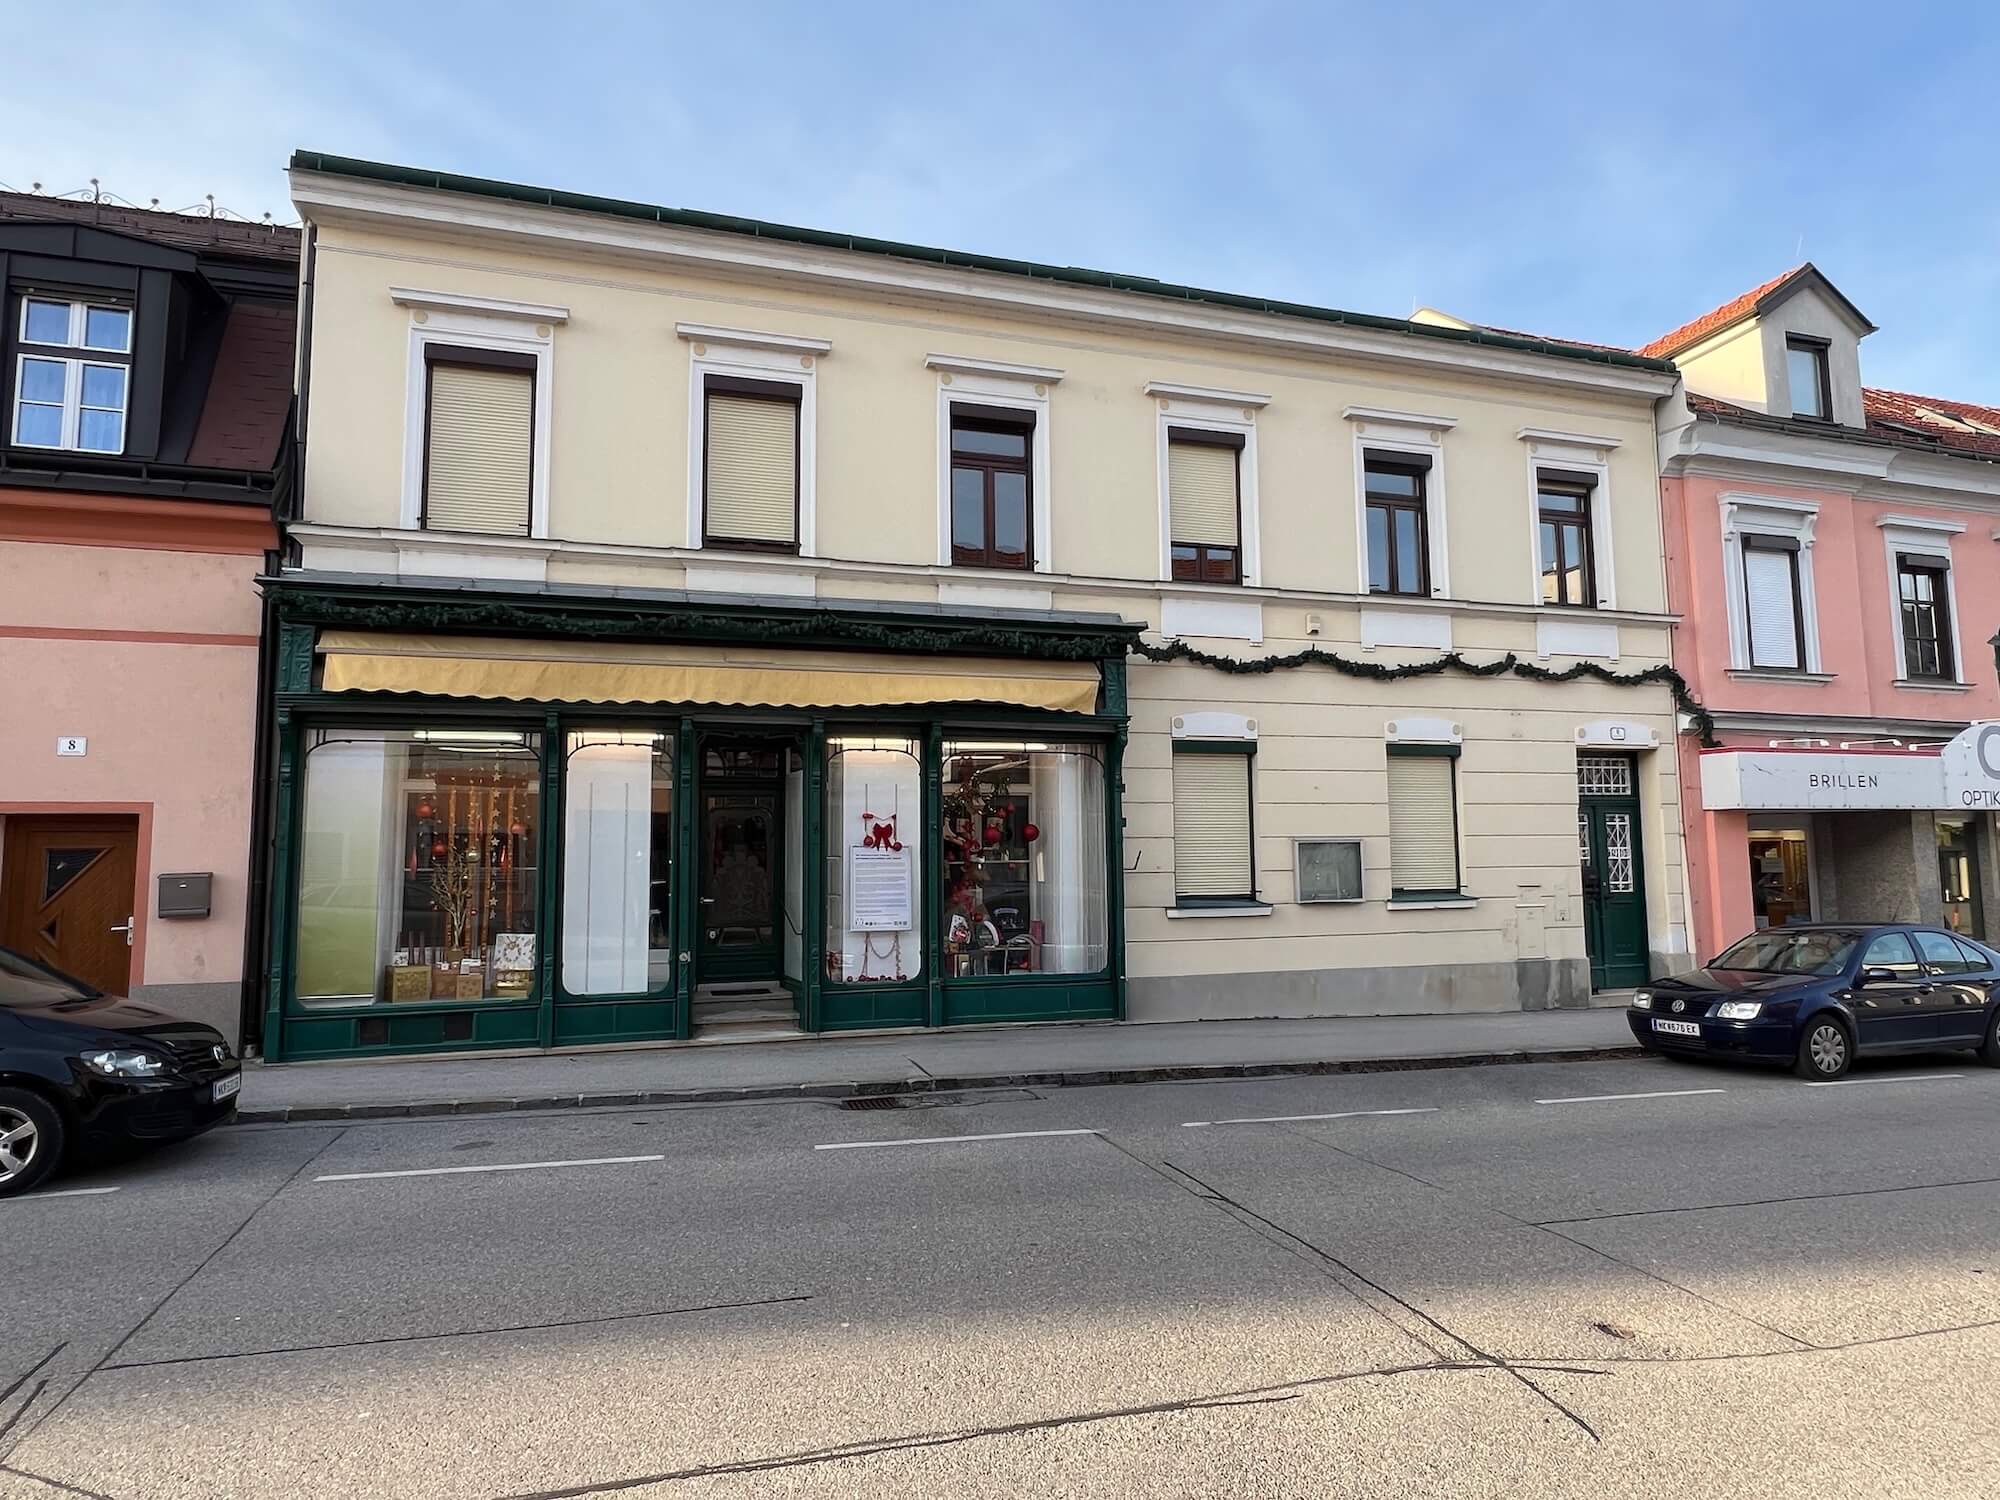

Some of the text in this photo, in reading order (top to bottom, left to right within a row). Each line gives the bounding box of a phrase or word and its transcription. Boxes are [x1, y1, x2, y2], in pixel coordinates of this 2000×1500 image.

[68, 739, 76, 750] 8
[1809, 774, 1878, 788] BRILLEN
[1961, 790, 2000, 807] OPTIK
